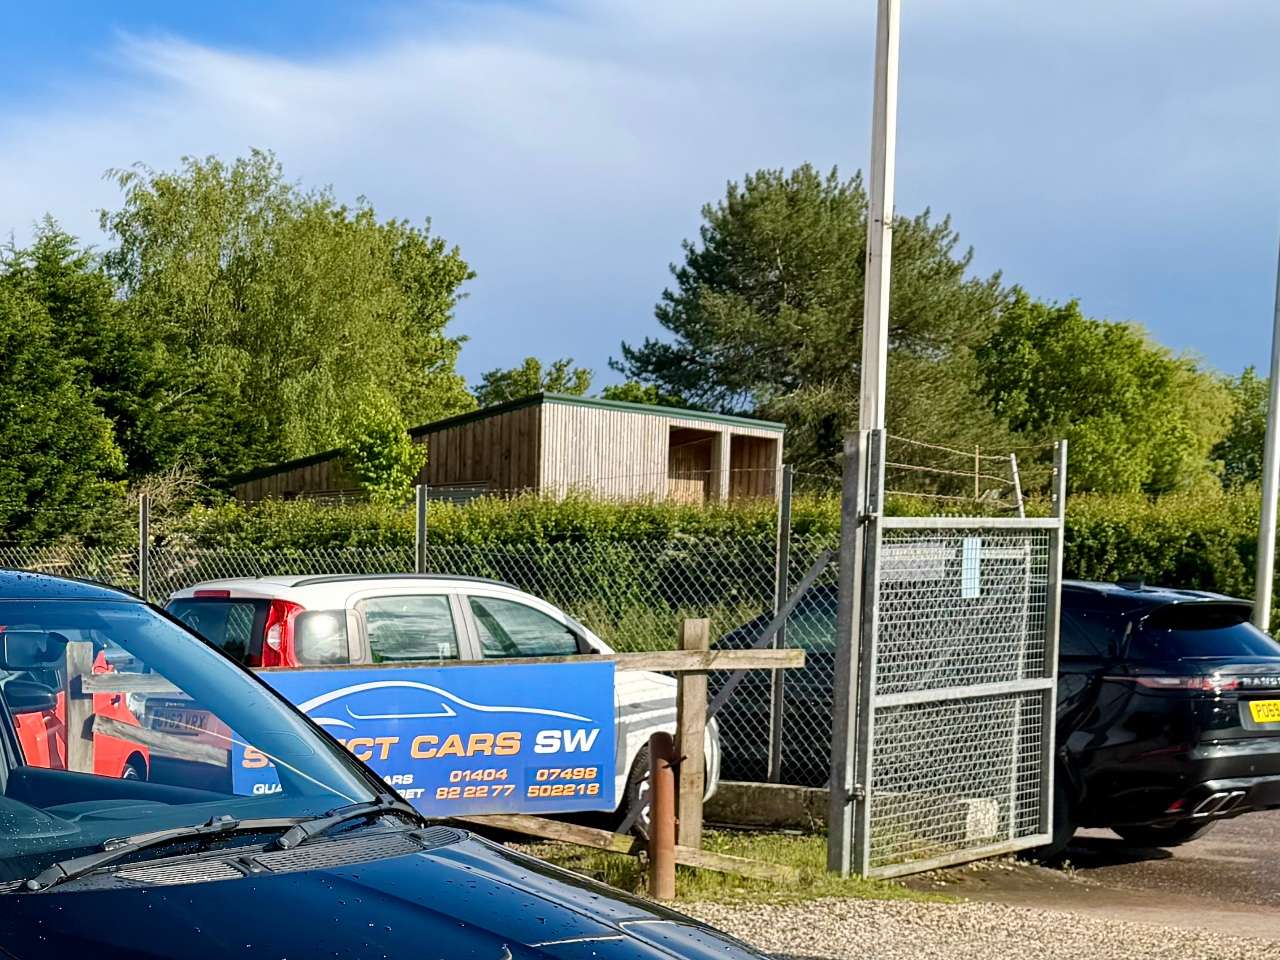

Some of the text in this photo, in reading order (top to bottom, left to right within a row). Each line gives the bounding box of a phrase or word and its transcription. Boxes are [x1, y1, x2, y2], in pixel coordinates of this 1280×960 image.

[410, 731, 522, 759] CARS
[534, 728, 601, 754] SW
[449, 768, 508, 783] 01404
[527, 783, 600, 798] 502218
